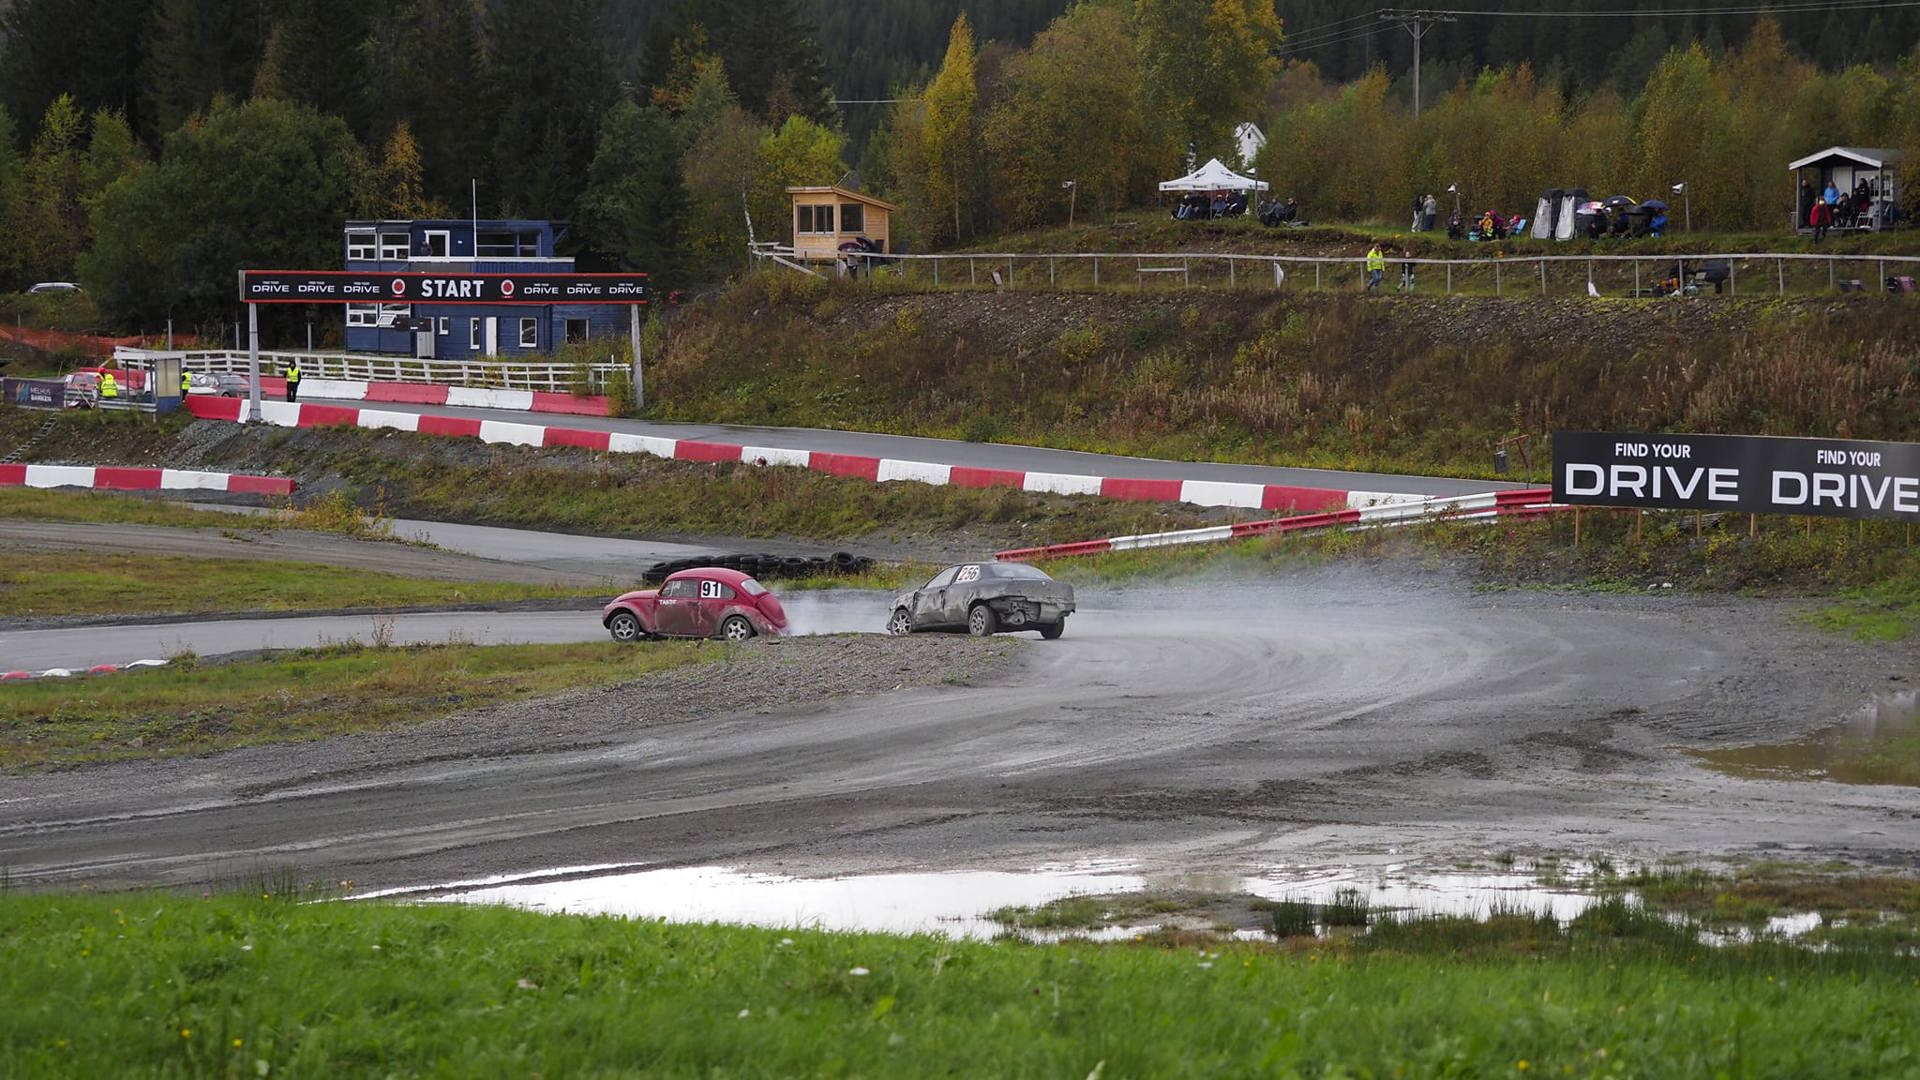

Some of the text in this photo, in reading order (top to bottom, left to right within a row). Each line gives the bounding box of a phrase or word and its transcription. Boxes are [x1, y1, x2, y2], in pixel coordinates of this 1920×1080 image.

[252, 284, 290, 293] DRIVE
[298, 284, 335, 293] DRIVE
[343, 285, 380, 294] DRIVE
[421, 279, 485, 298] START
[524, 286, 559, 294] DRIVE
[567, 286, 601, 294] DRIVE
[609, 286, 643, 294] DRIVE
[1615, 442, 1691, 459] FIND YOUR
[1816, 449, 1882, 468] FIND YOUR
[1565, 463, 1740, 502] DRIVE
[1771, 470, 1920, 514] DRIVE
[702, 581, 720, 598] 91
